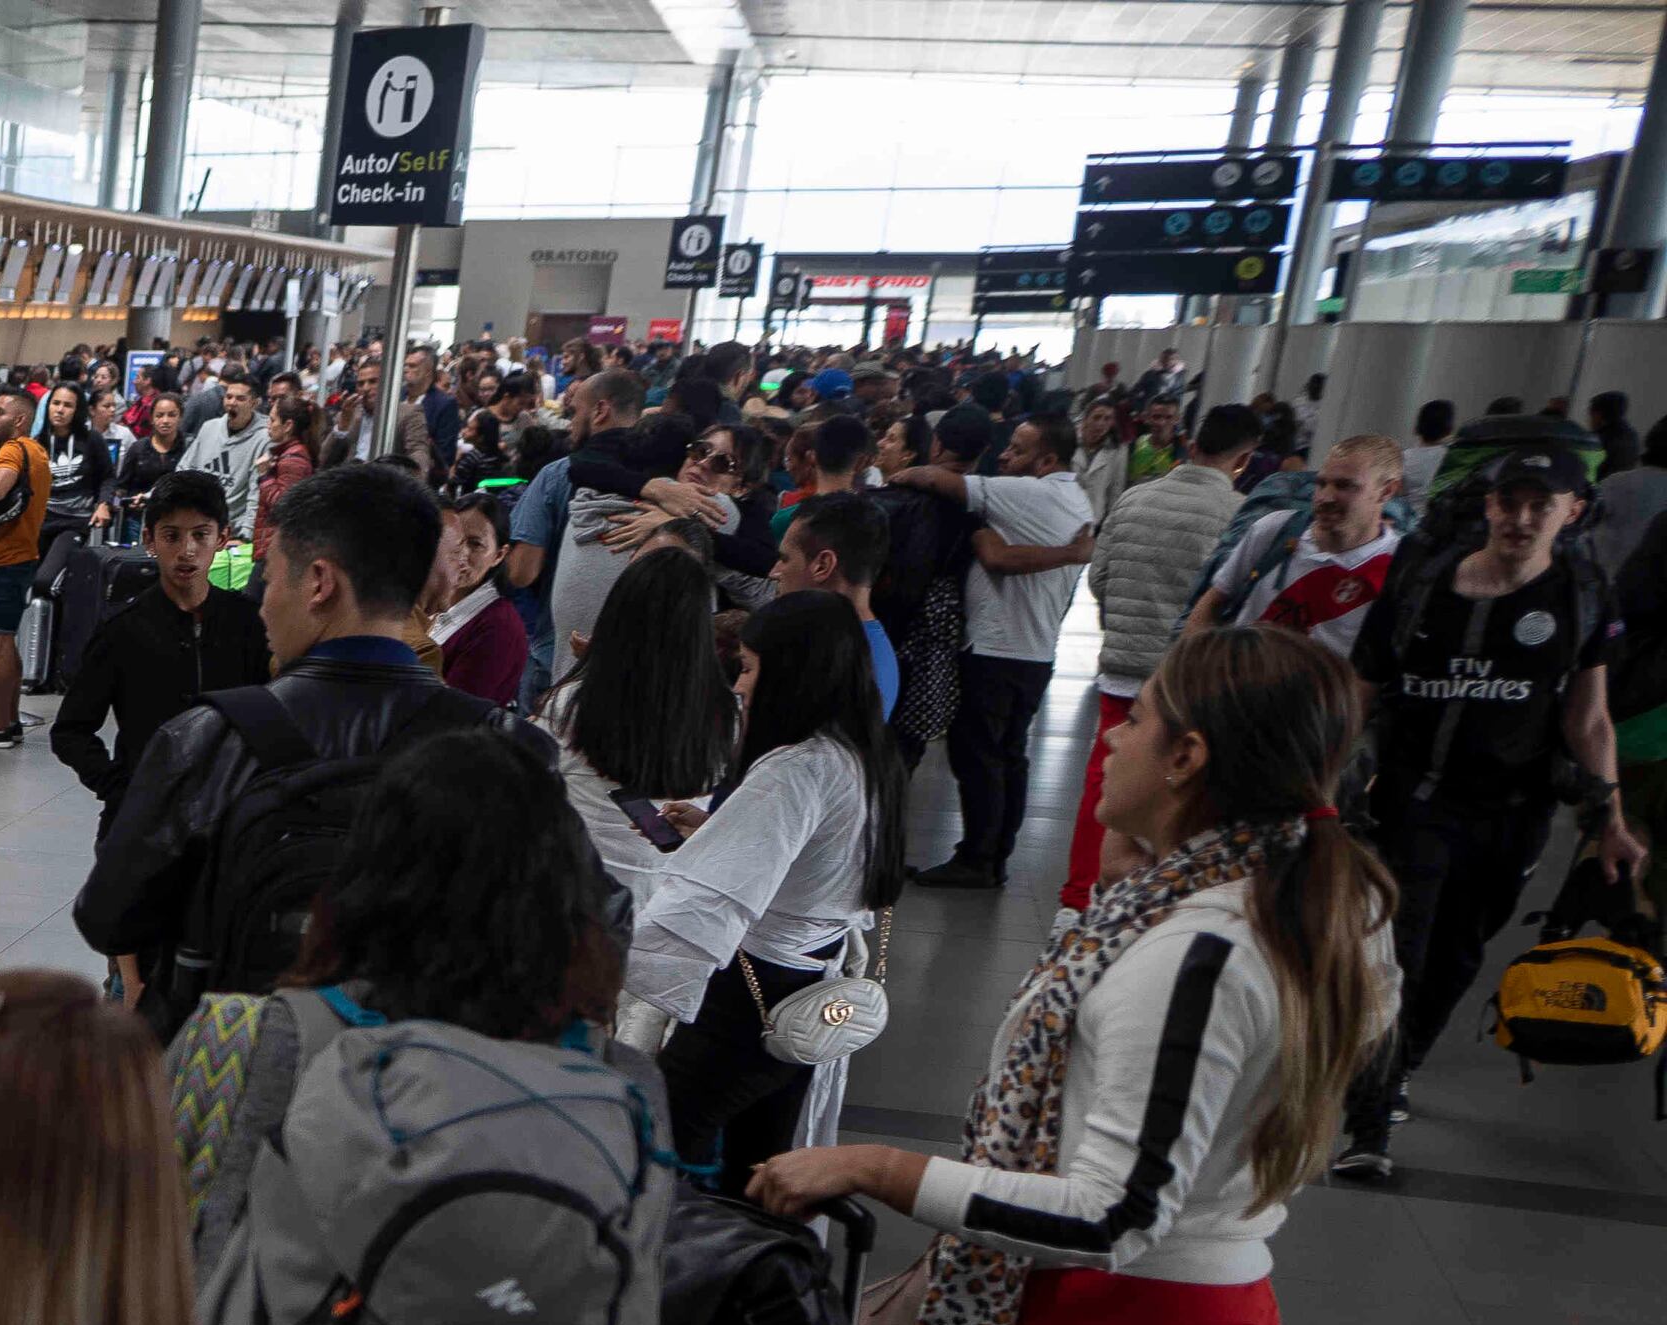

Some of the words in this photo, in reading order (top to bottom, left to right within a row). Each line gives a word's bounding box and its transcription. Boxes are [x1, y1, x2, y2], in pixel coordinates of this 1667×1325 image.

[337, 180, 426, 204] Check-in
[530, 249, 619, 264] ORATORIO
[811, 275, 866, 288] SIST
[1450, 656, 1494, 678] Fly
[1402, 672, 1534, 701] Emirates
